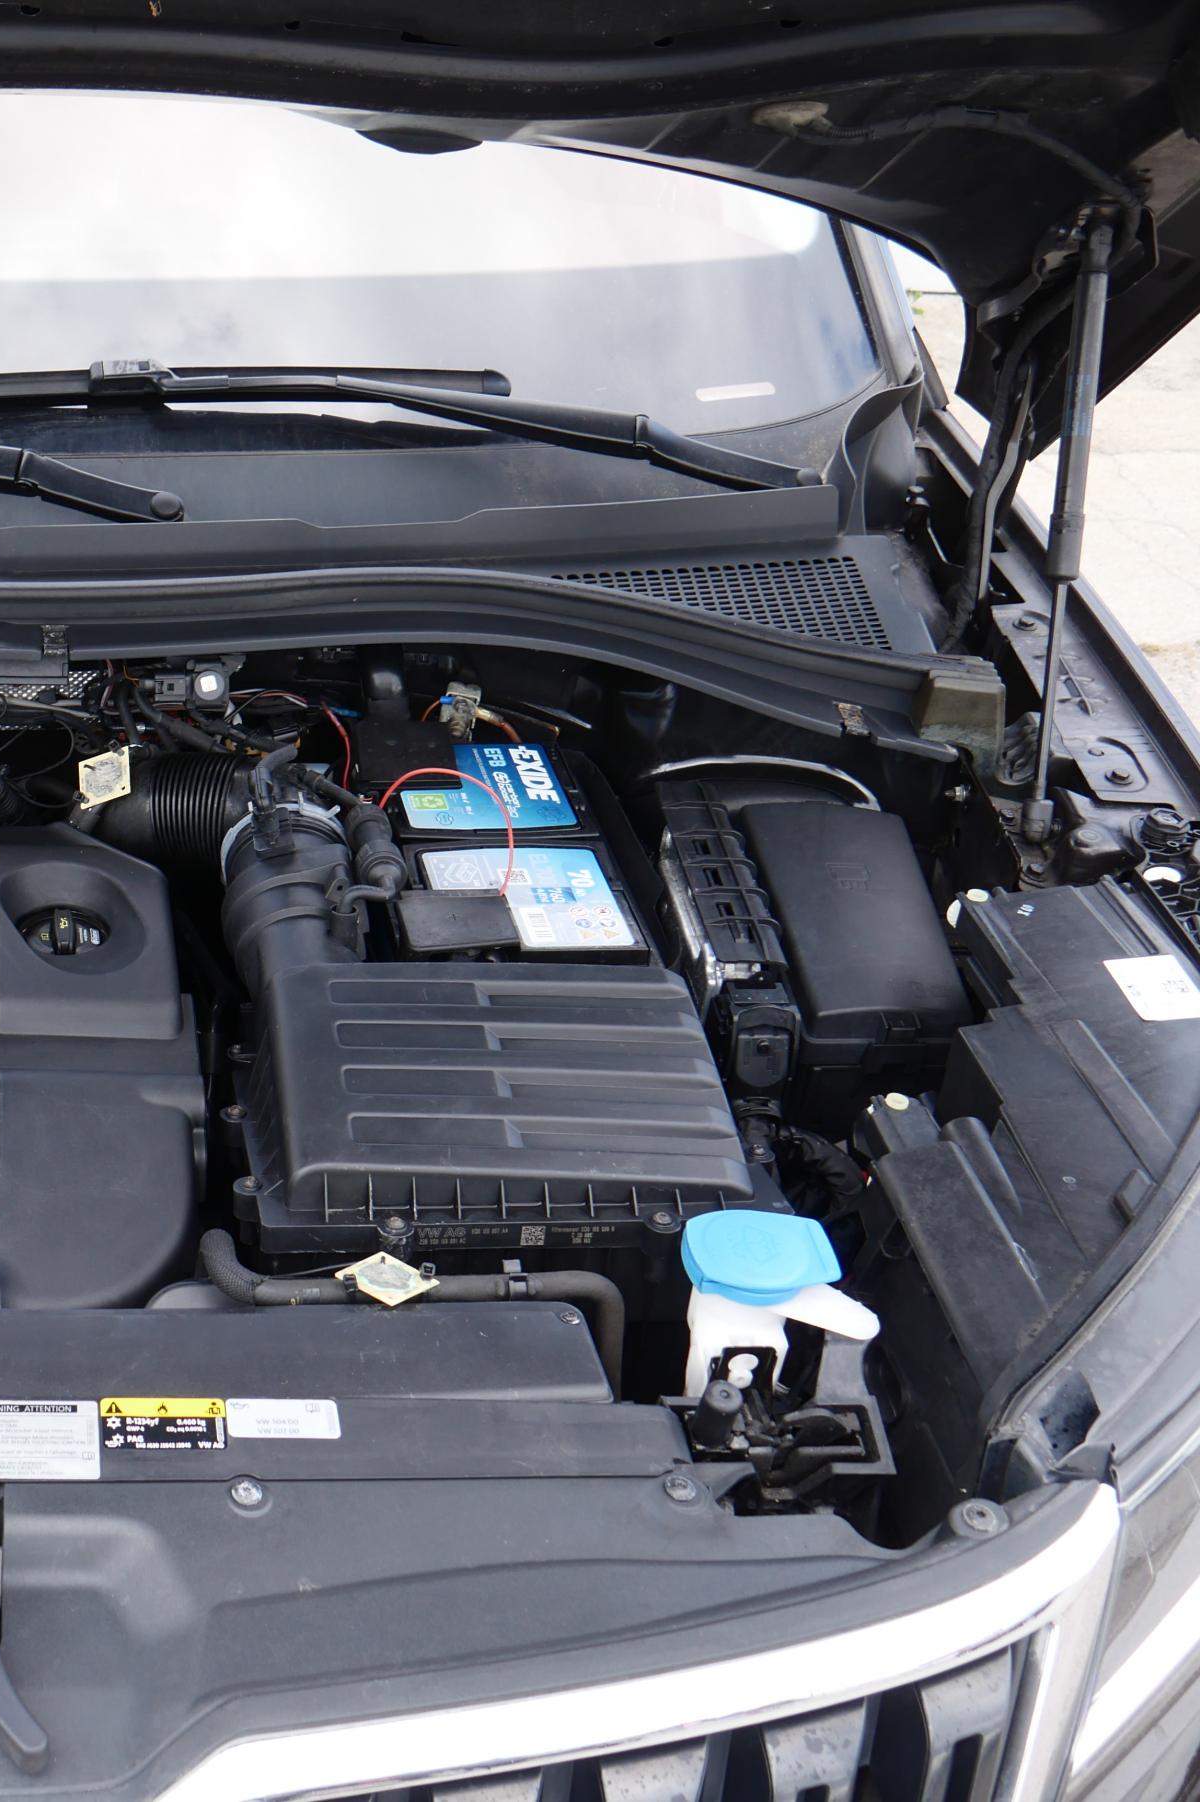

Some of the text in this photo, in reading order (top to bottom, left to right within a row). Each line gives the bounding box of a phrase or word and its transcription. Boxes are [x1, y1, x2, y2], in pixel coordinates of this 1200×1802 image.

[483, 748, 506, 767] EFB
[508, 745, 560, 803] EXIDE
[567, 869, 595, 888] 70
[417, 1226, 466, 1239] VW AG
[23, 1404, 72, 1413] ATTENTION
[126, 1434, 145, 1443] PAG
[197, 1440, 225, 1449] VW AG
